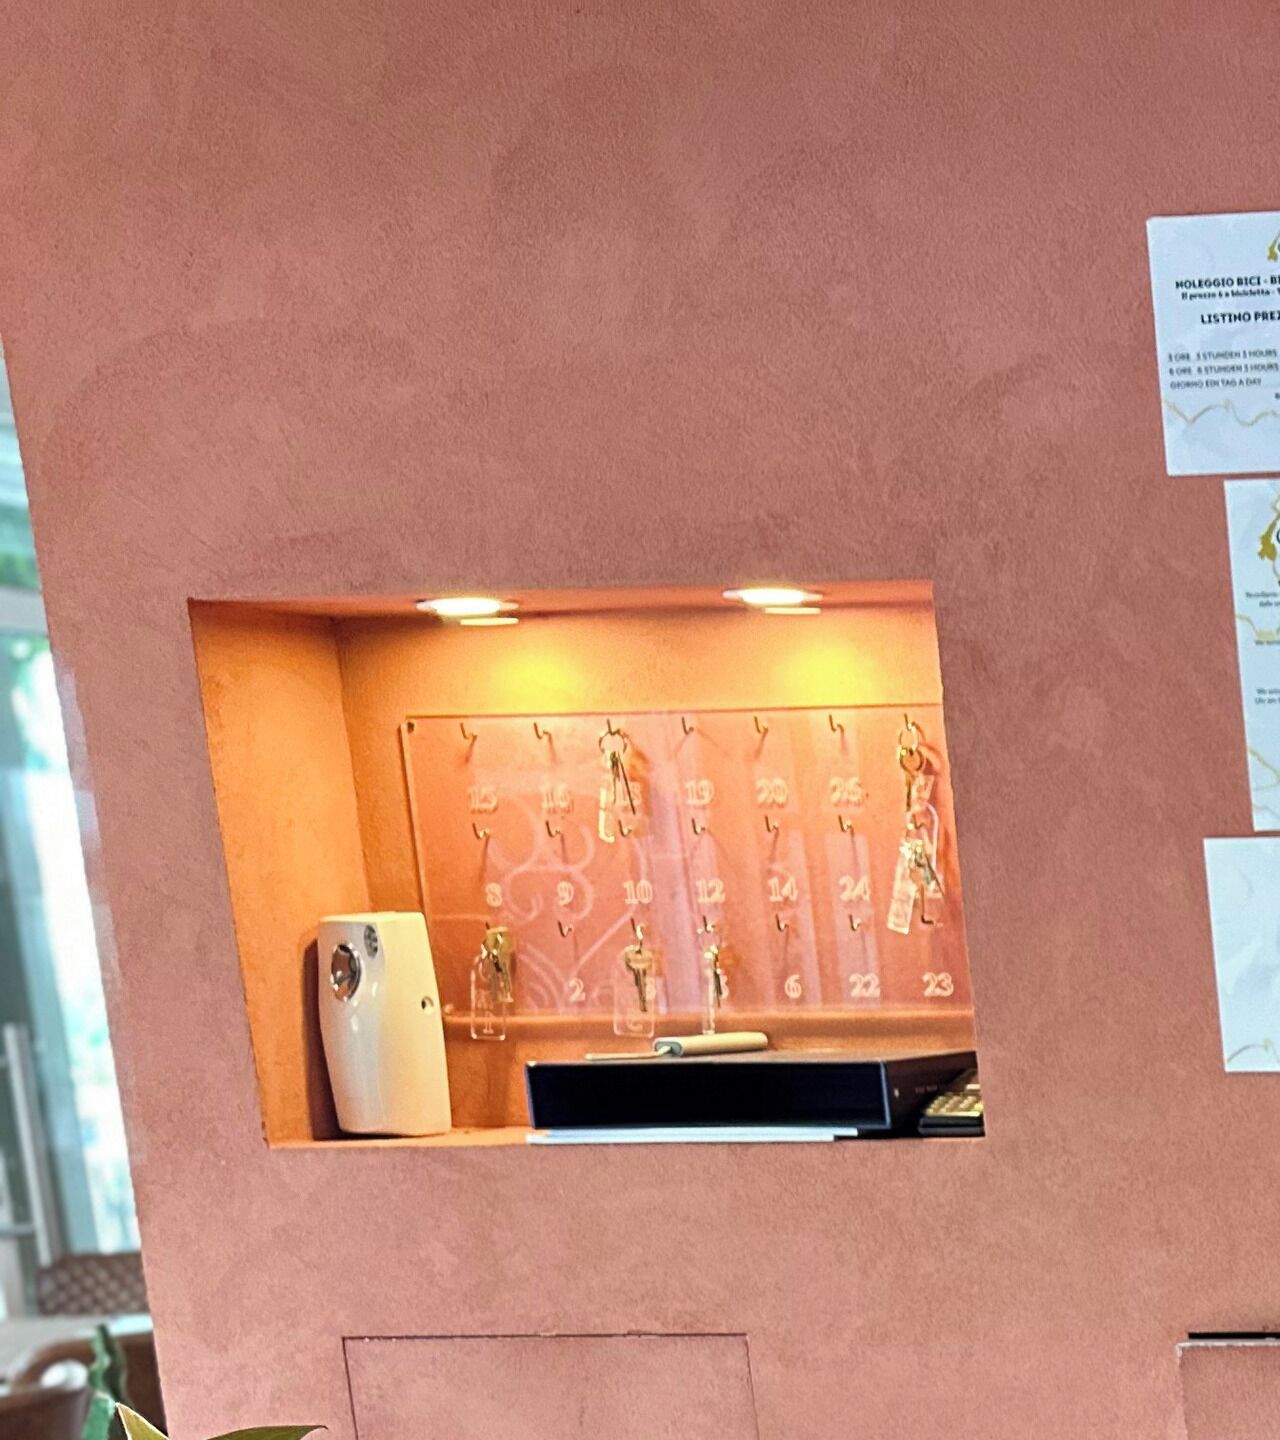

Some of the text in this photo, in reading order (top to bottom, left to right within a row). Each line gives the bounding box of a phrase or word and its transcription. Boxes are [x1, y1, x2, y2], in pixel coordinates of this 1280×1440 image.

[1176, 277, 1234, 289] NOLEGGIO
[1237, 275, 1261, 287] BICI
[1201, 312, 1251, 325] LISTINO
[1203, 350, 1241, 361] STUNDEN
[1249, 348, 1278, 358] HOURS
[1250, 362, 1279, 373] HOURS
[684, 779, 715, 806] 19
[755, 777, 789, 804] 20
[485, 875, 872, 907] 8 9 10 12 14 24
[568, 972, 954, 1002] 2 6 22 23
